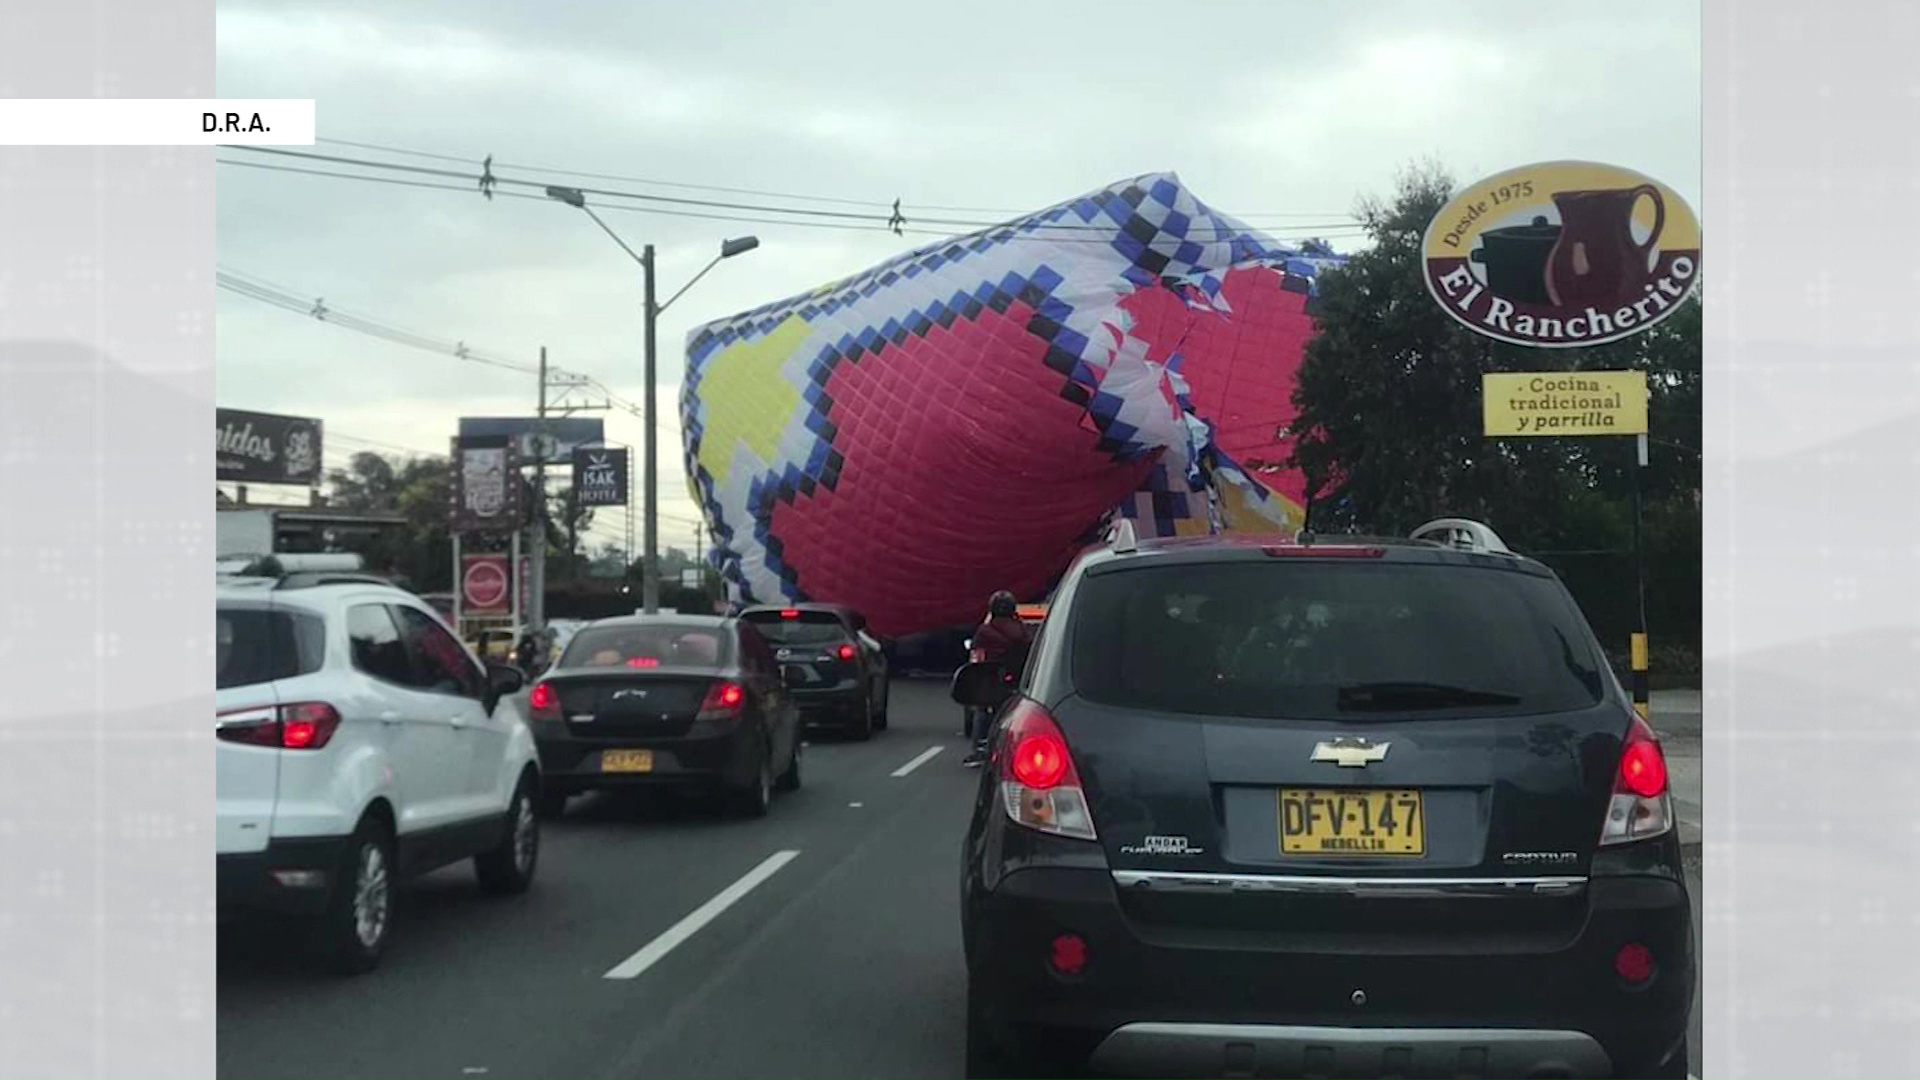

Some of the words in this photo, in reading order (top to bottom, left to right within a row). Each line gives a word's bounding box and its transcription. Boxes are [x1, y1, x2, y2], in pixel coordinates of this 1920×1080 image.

[1443, 200, 1488, 249] Desde
[1491, 180, 1534, 206] 1975
[1438, 264, 1484, 311] El
[1484, 256, 1695, 338] Rancherito
[1529, 377, 1600, 393] Cocina
[1509, 393, 1621, 411] tradicional
[1516, 415, 1530, 432] y
[1534, 411, 1615, 432] parrilla
[582, 470, 617, 487] ISAK
